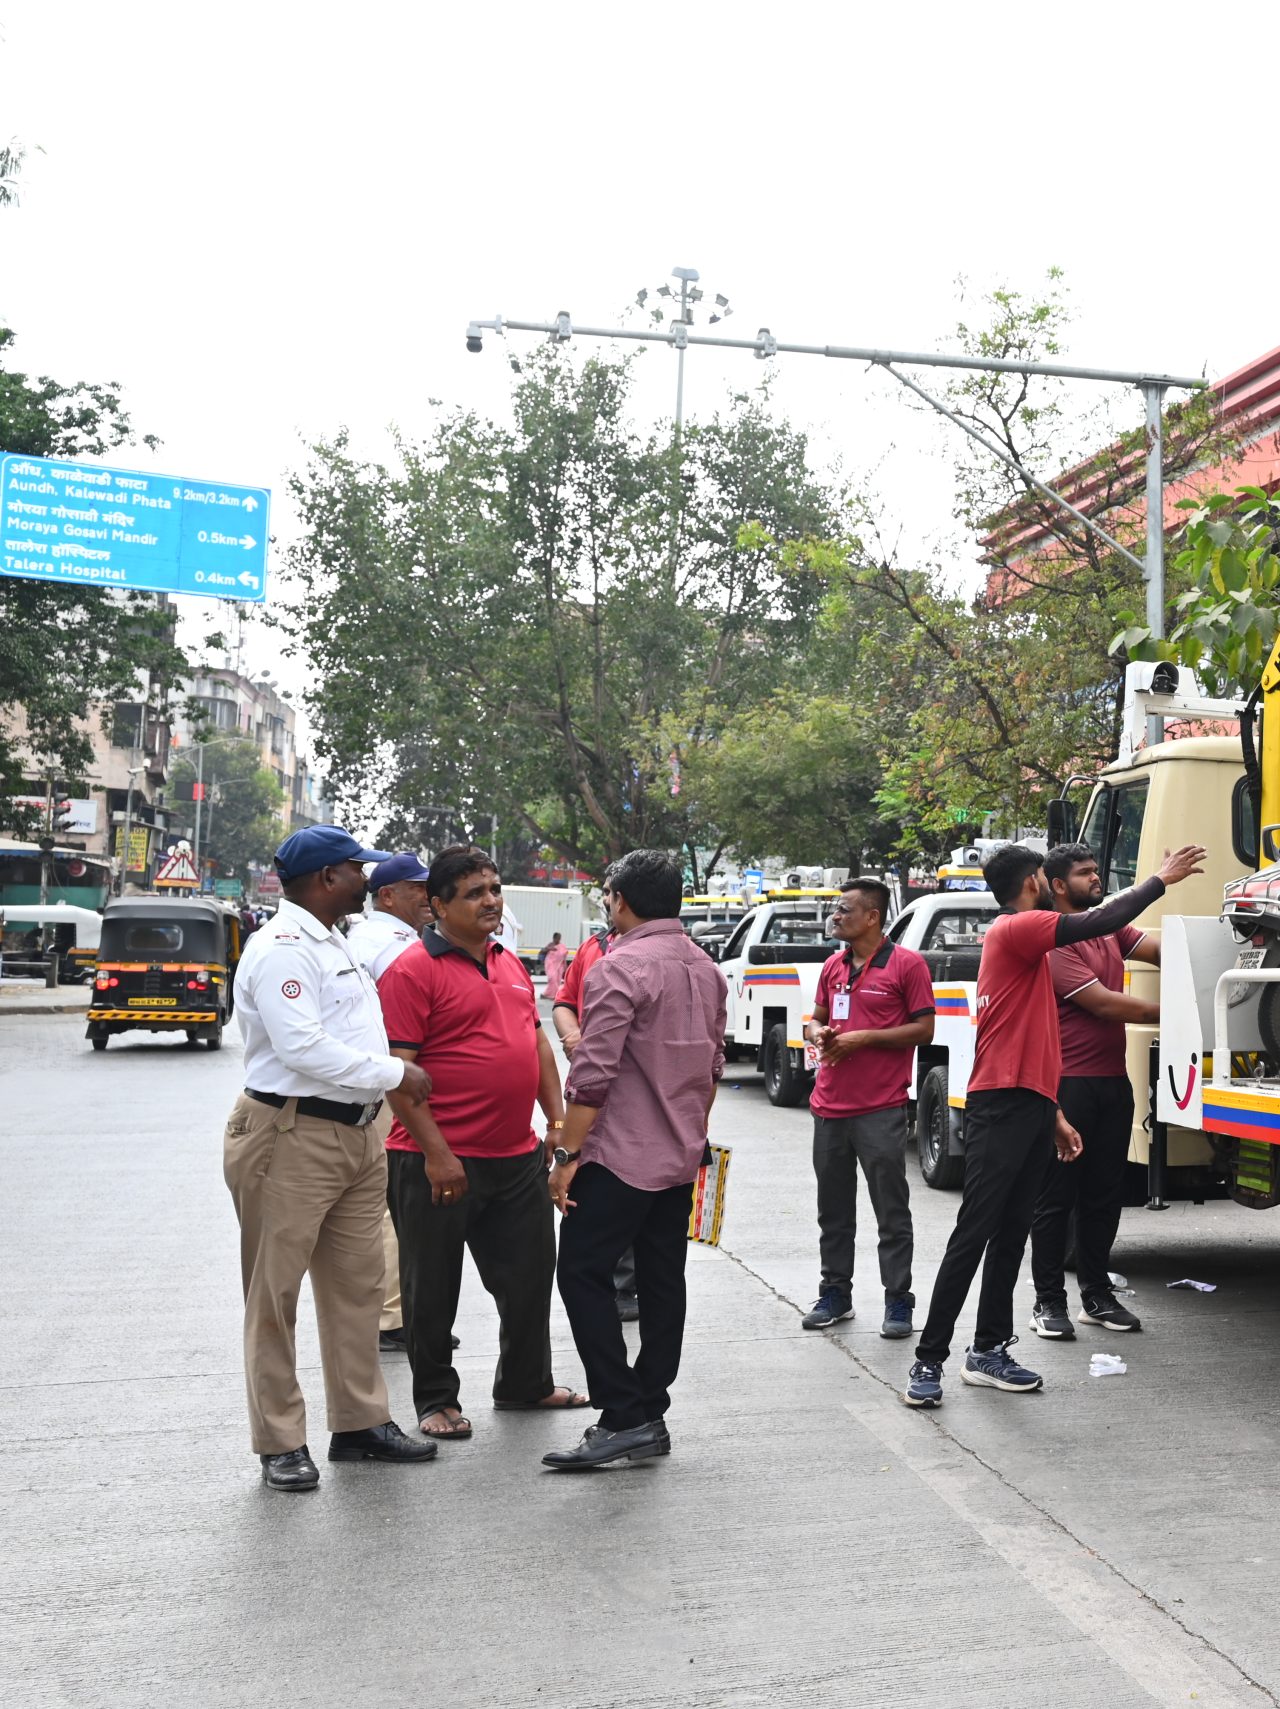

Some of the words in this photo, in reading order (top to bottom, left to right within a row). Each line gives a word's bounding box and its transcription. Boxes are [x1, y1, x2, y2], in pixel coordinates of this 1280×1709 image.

[50, 469, 112, 486] काळेवाडी
[115, 476, 148, 491] फाटा
[9, 478, 58, 496] Aundh,
[65, 485, 127, 504] Kalewadi
[132, 493, 171, 510] Phata
[7, 499, 48, 517] मोरया
[51, 504, 98, 522] गोसावी
[102, 511, 135, 527] मंदिर
[7, 517, 58, 535] Moraya
[63, 524, 107, 541] Gosavi
[112, 530, 158, 545] Mandir
[197, 530, 238, 546] 0.5km
[5, 539, 48, 554] तालेरा
[4, 555, 54, 573] Talera
[60, 562, 127, 581] Hospital
[194, 570, 236, 586] 0.4km
